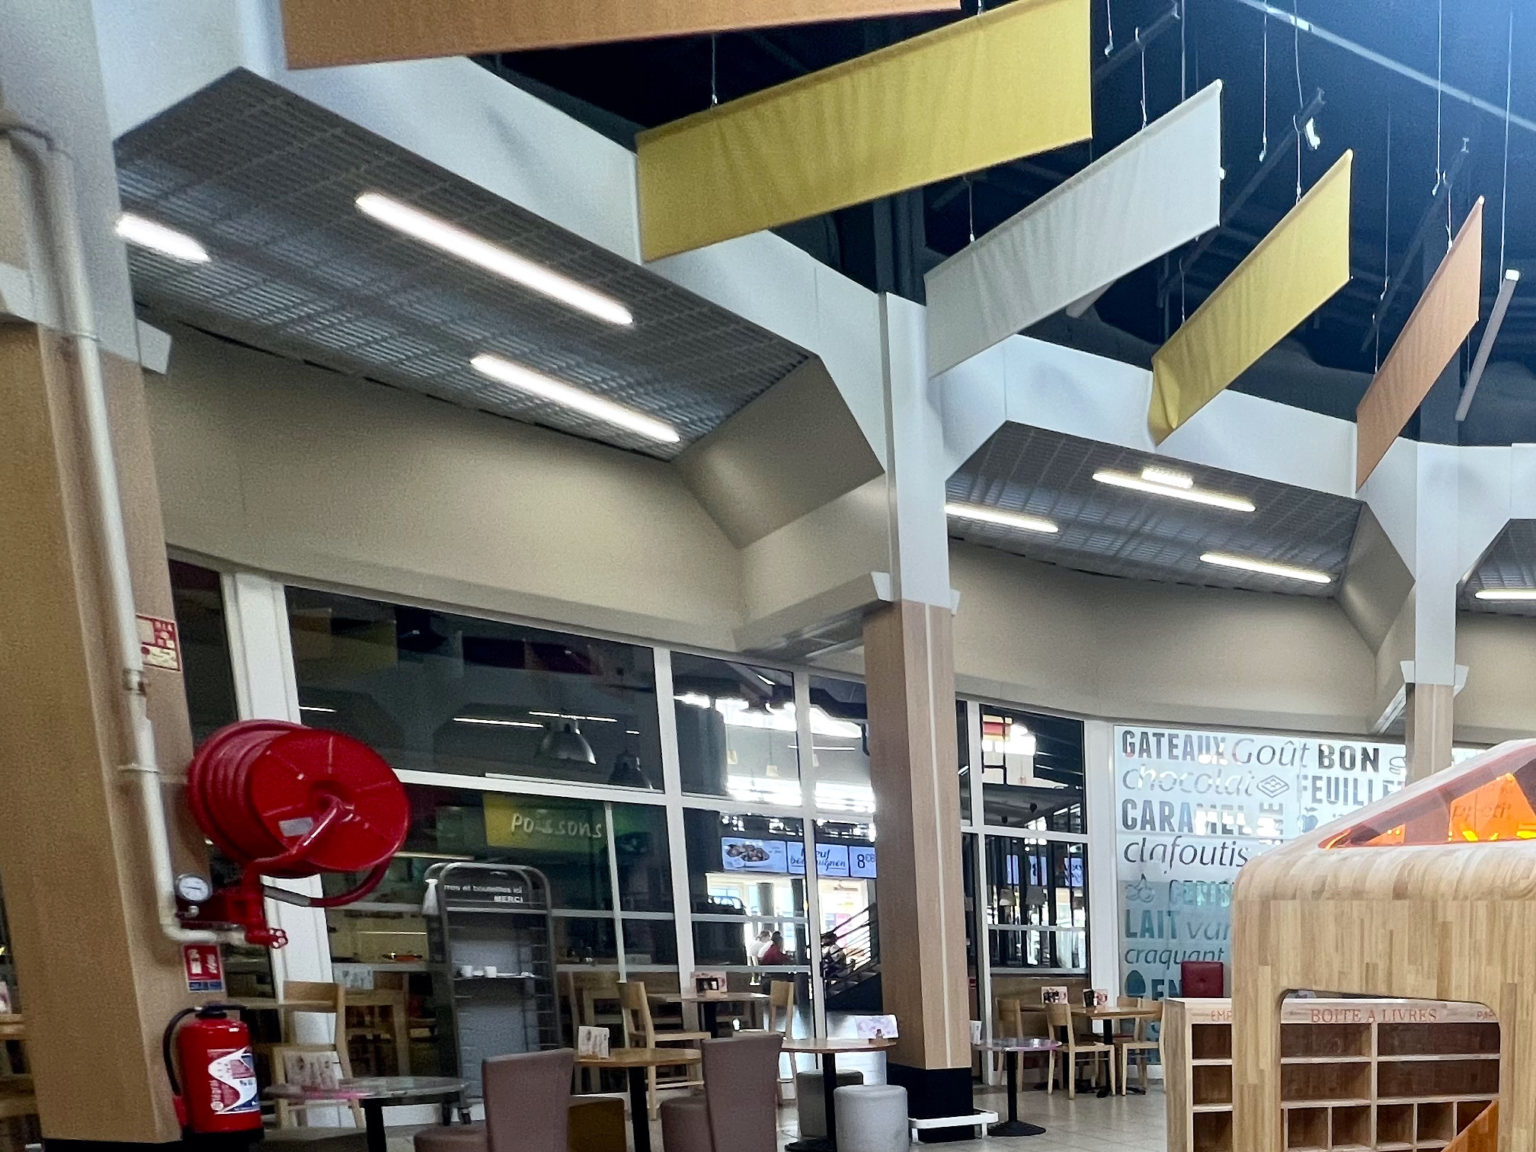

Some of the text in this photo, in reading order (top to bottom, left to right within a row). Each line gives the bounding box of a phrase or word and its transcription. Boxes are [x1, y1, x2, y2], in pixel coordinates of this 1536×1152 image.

[1232, 737, 1309, 768] Goût
[1317, 743, 1380, 773] BON
[1121, 798, 1252, 836] CARAMEL
[1123, 835, 1249, 870] clafoutis
[493, 895, 524, 903] MERCI
[1168, 879, 1234, 907] CERIS
[1125, 909, 1180, 939] LAIT
[1382, 1008, 1438, 1023] LIVRES
